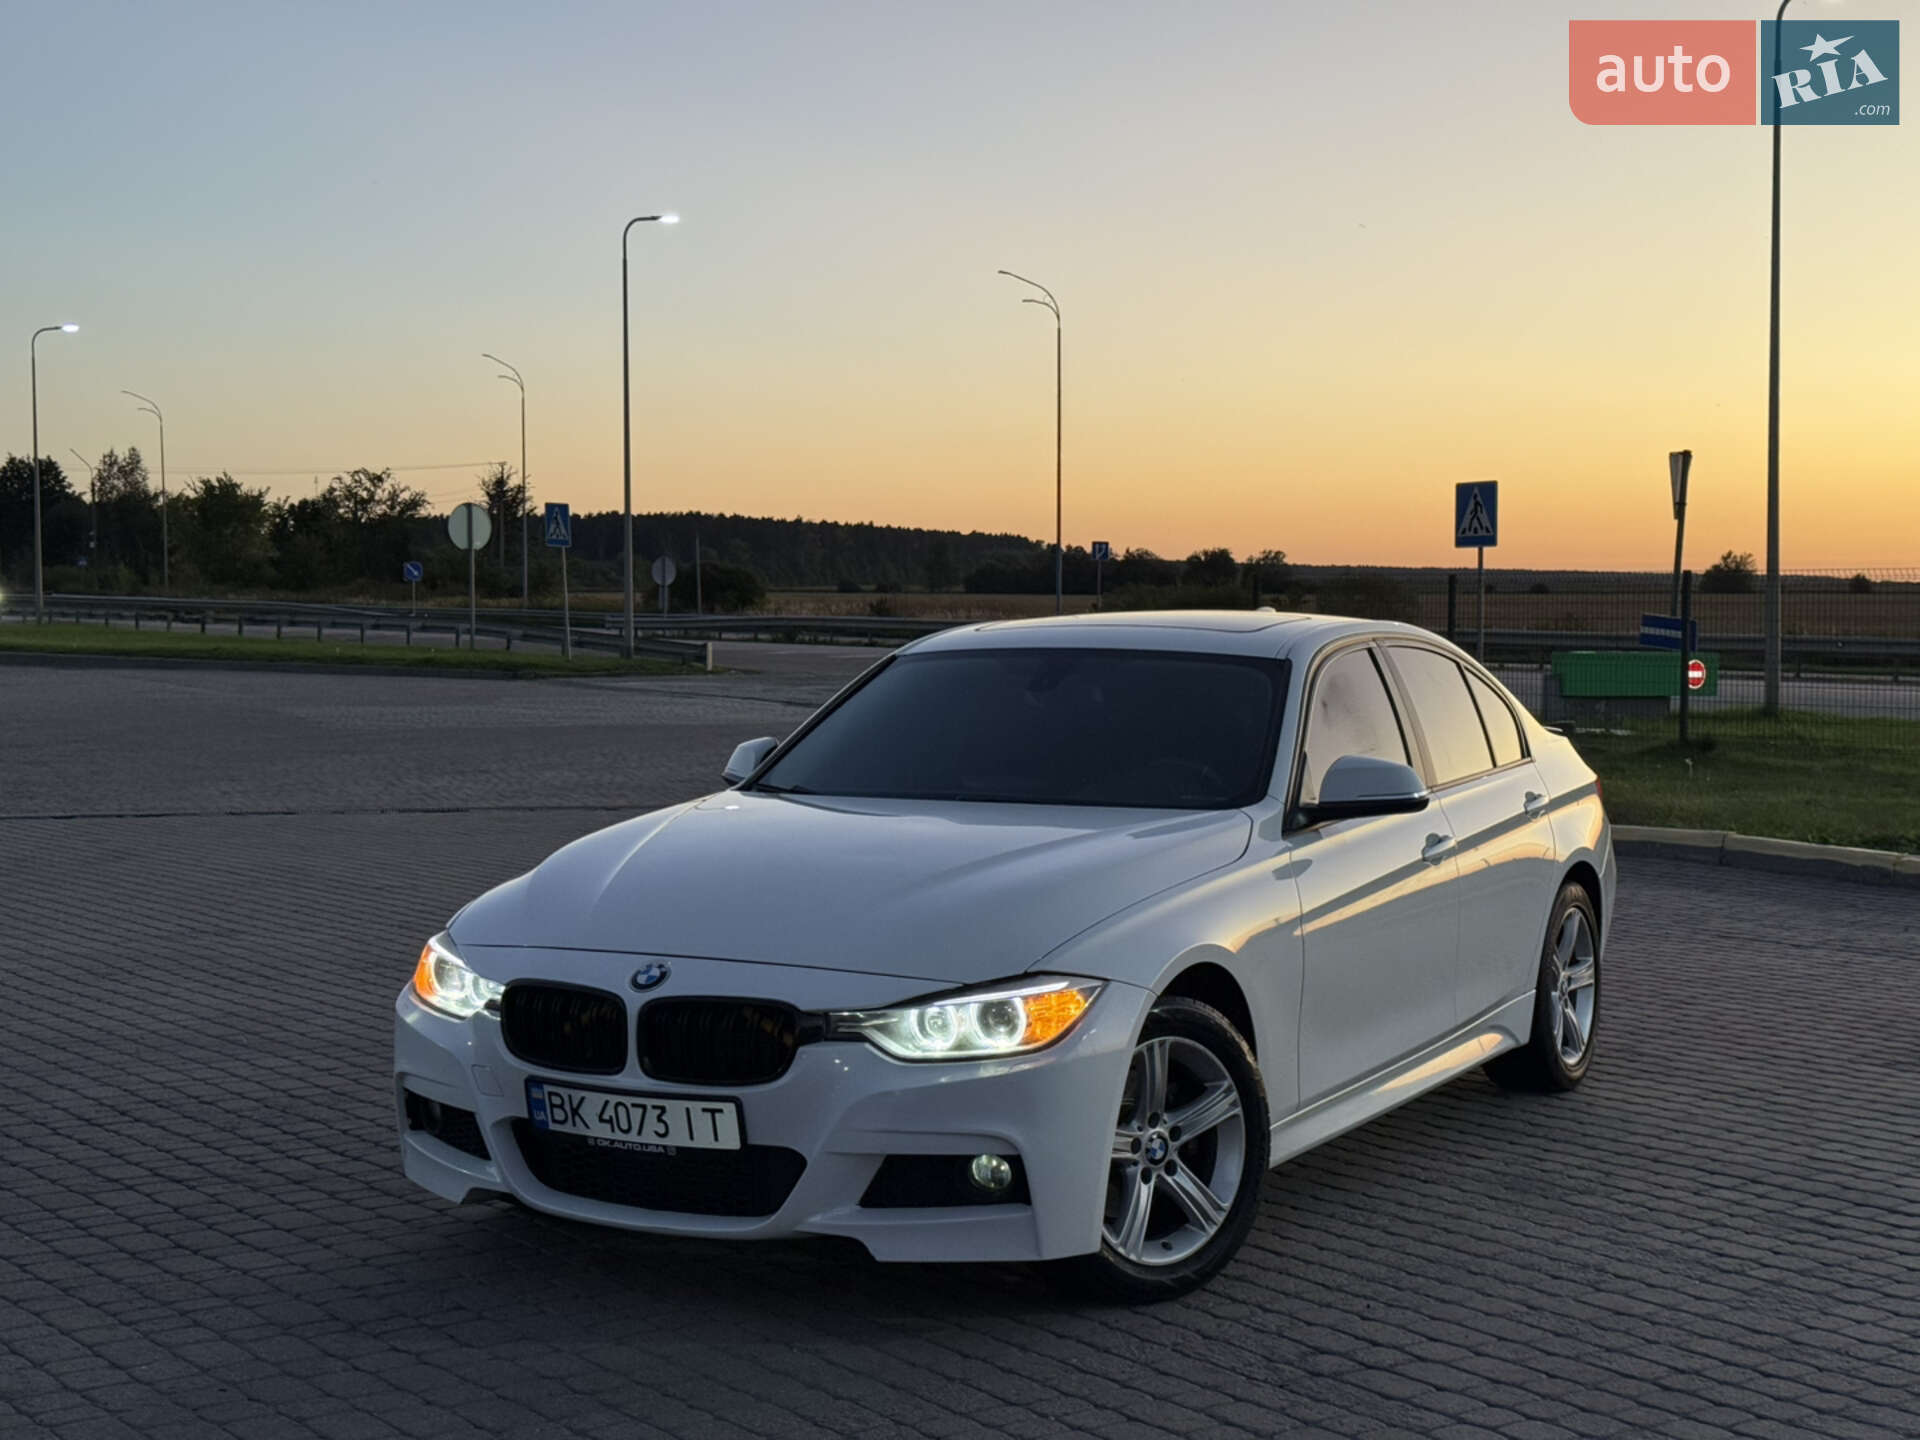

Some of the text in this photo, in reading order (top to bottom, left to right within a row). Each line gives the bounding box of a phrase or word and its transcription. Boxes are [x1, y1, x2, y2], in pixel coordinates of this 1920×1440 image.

[548, 1091, 724, 1142] BK 4073 IT
